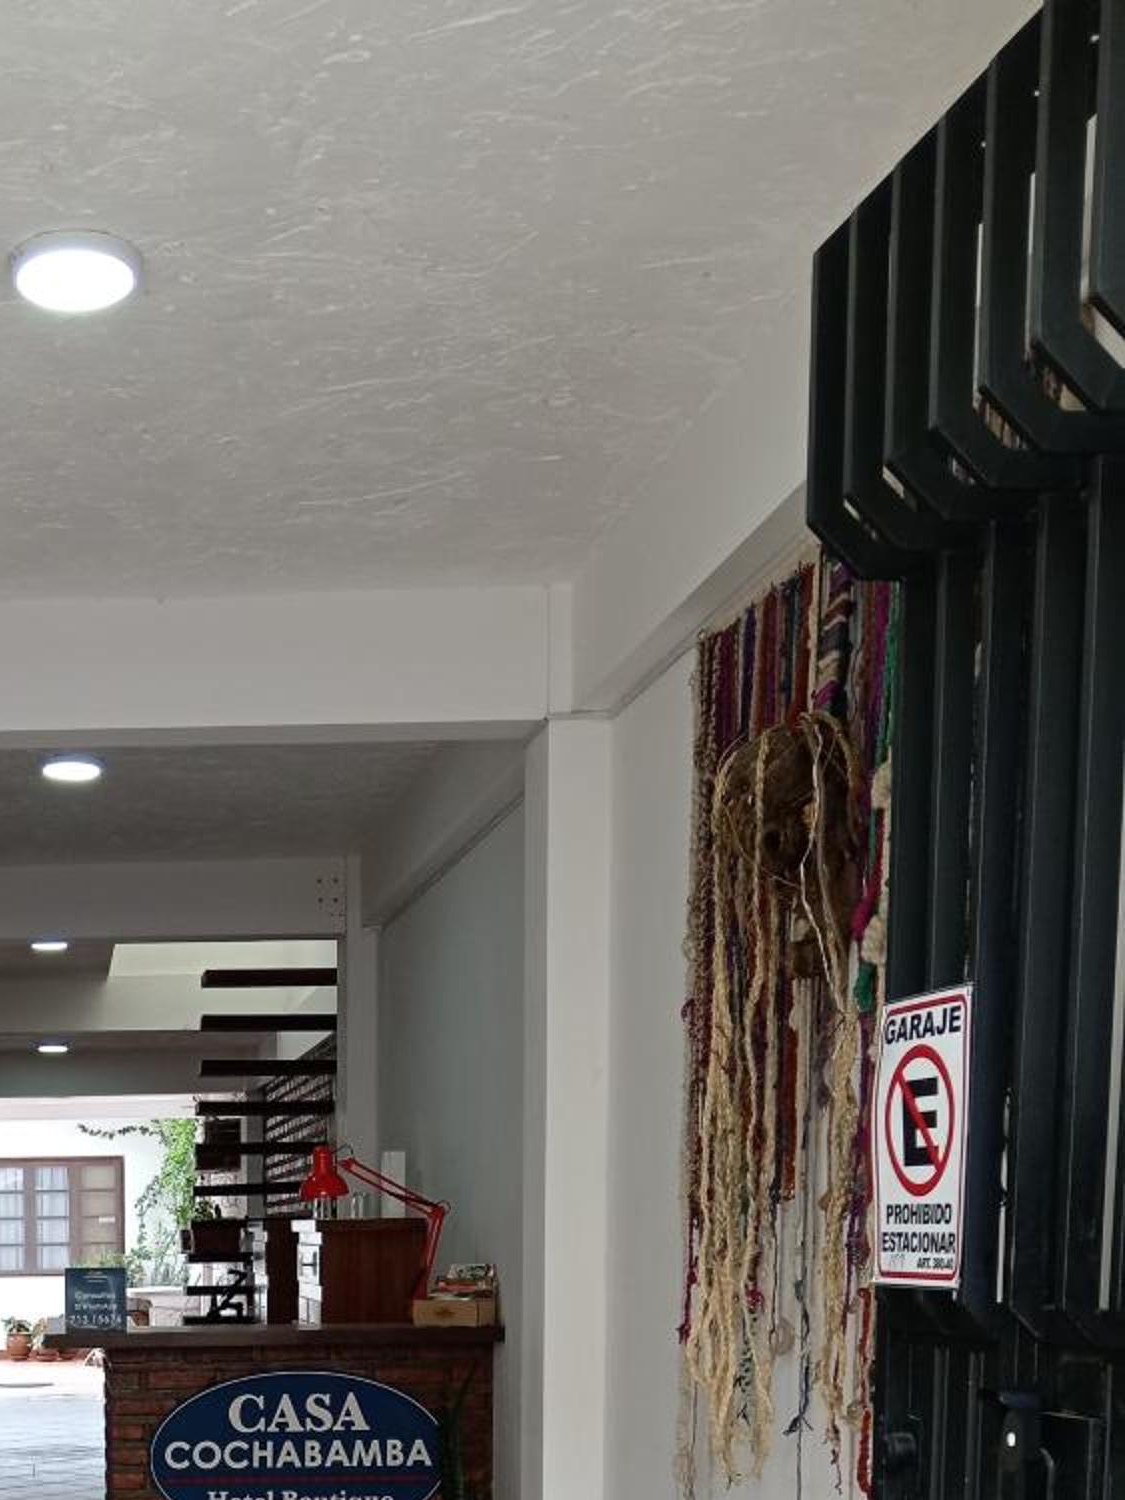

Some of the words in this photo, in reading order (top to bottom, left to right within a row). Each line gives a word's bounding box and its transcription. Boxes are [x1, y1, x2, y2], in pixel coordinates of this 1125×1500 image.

[885, 1005, 961, 1045] GARAJE
[902, 1077, 939, 1167] E
[886, 1203, 952, 1225] PROHIBIDO
[882, 1232, 956, 1253] ESTACIONAR
[228, 1391, 371, 1433] CASA
[164, 1439, 432, 1469] COCHABAMBA
